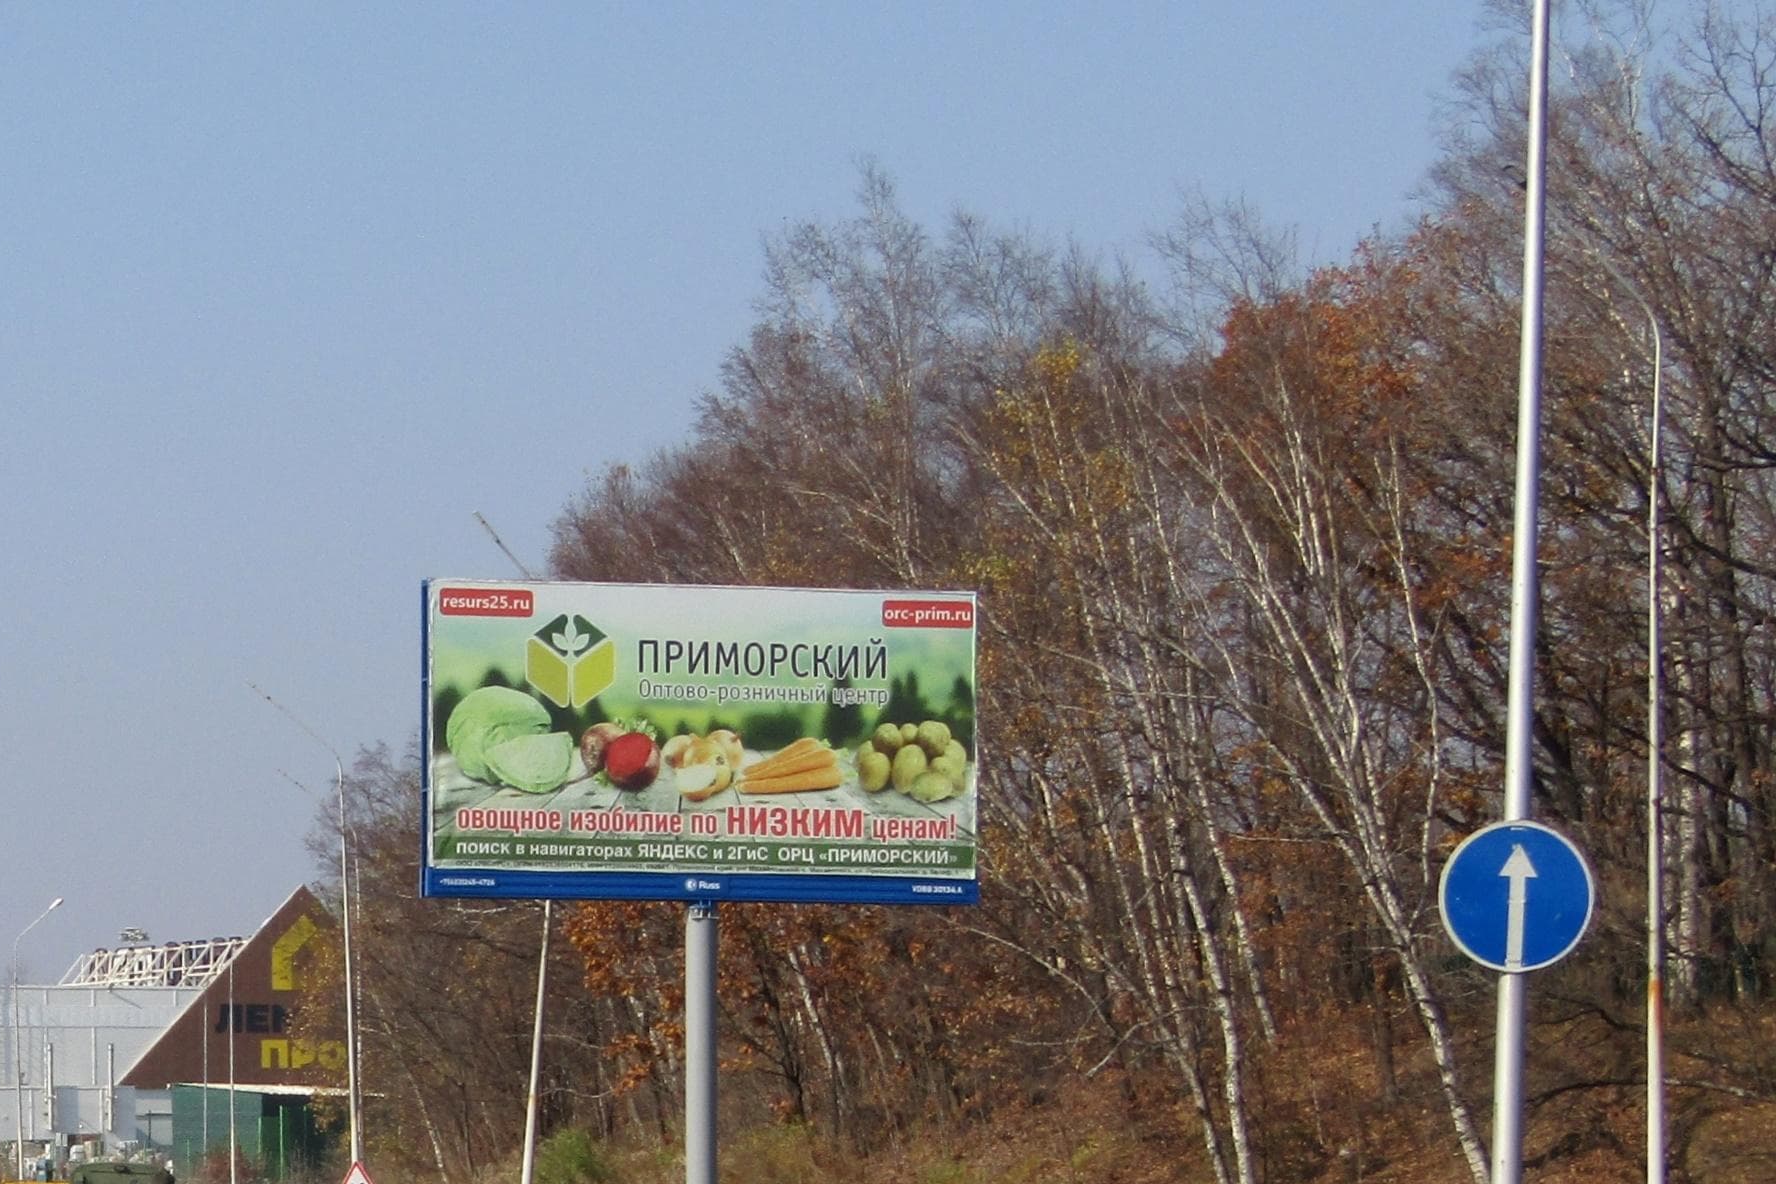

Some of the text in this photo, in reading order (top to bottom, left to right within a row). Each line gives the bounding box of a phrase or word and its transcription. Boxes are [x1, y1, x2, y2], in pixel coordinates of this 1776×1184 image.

[443, 595, 530, 609] resurs25.ru
[884, 605, 972, 624] orc-prim.ru
[637, 637, 888, 679] ПРИМОРСКИЙ
[639, 679, 889, 707] Оптово-розничный центр
[457, 805, 957, 843] овощное изобилие по НИЗКИМ ценам!
[515, 844, 525, 855] в
[529, 844, 633, 860] навигаторах
[637, 843, 708, 861] ЯНДЕКС
[712, 848, 723, 860] и
[777, 847, 815, 864] ОРЦ
[818, 847, 958, 864] «ПРИМОРСКИЙ»
[698, 880, 721, 890] Russ
